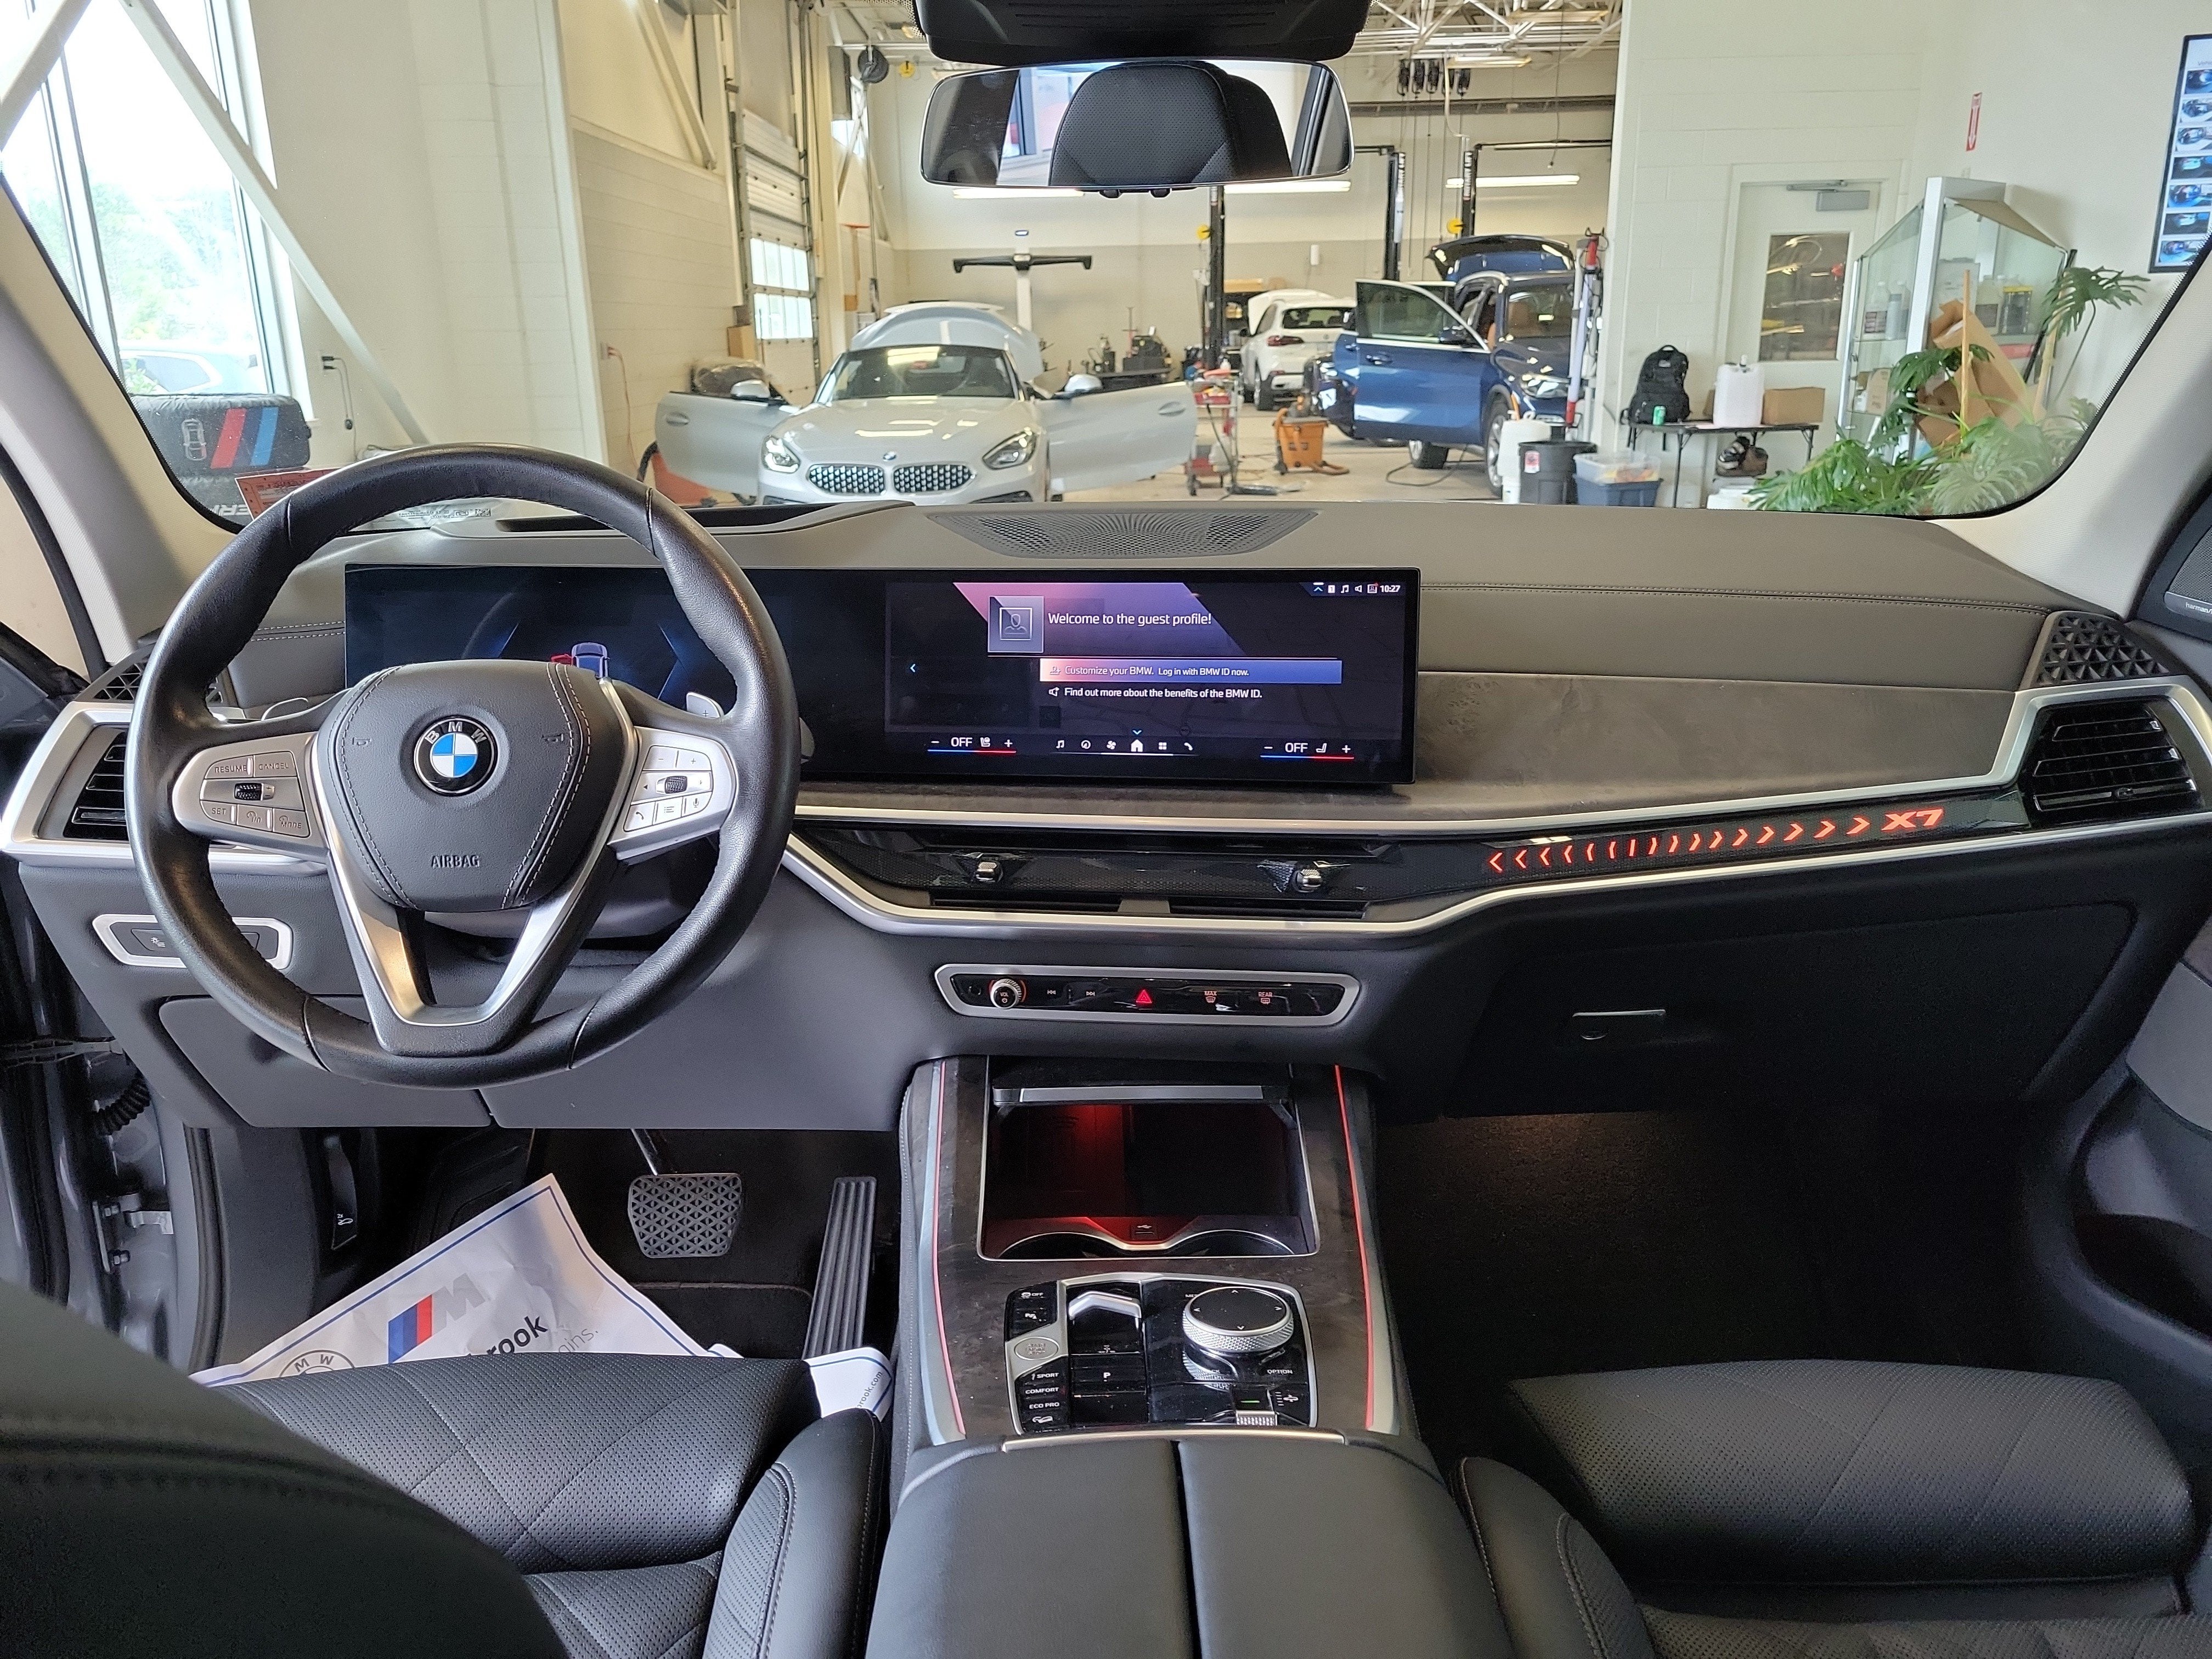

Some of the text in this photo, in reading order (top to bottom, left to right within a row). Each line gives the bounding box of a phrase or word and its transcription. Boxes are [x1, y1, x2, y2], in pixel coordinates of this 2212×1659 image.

[1048, 613, 1211, 627] Welcome to the guest profile!
[1065, 666, 1154, 677] Customize your BMW.
[1158, 667, 1172, 676] Log
[1200, 668, 1220, 676] BMW
[1221, 668, 1230, 676] ID
[1064, 687, 1084, 696] Find
[1085, 688, 1098, 697] out
[1124, 688, 1148, 697] about
[1149, 688, 1163, 697] the
[1164, 688, 1198, 697] benefits
[1199, 689, 1209, 697] of
[1209, 689, 1224, 698] the
[1225, 689, 1250, 698] BMW
[1250, 689, 1262, 698] ID.
[425, 721, 487, 744] BMW
[951, 737, 973, 747] OFF
[1285, 742, 1308, 753] OFF
[215, 765, 247, 773] RESUME
[1881, 809, 1942, 831] X7
[431, 854, 480, 868] AIRBAG
[294, 1354, 334, 1373] MW
